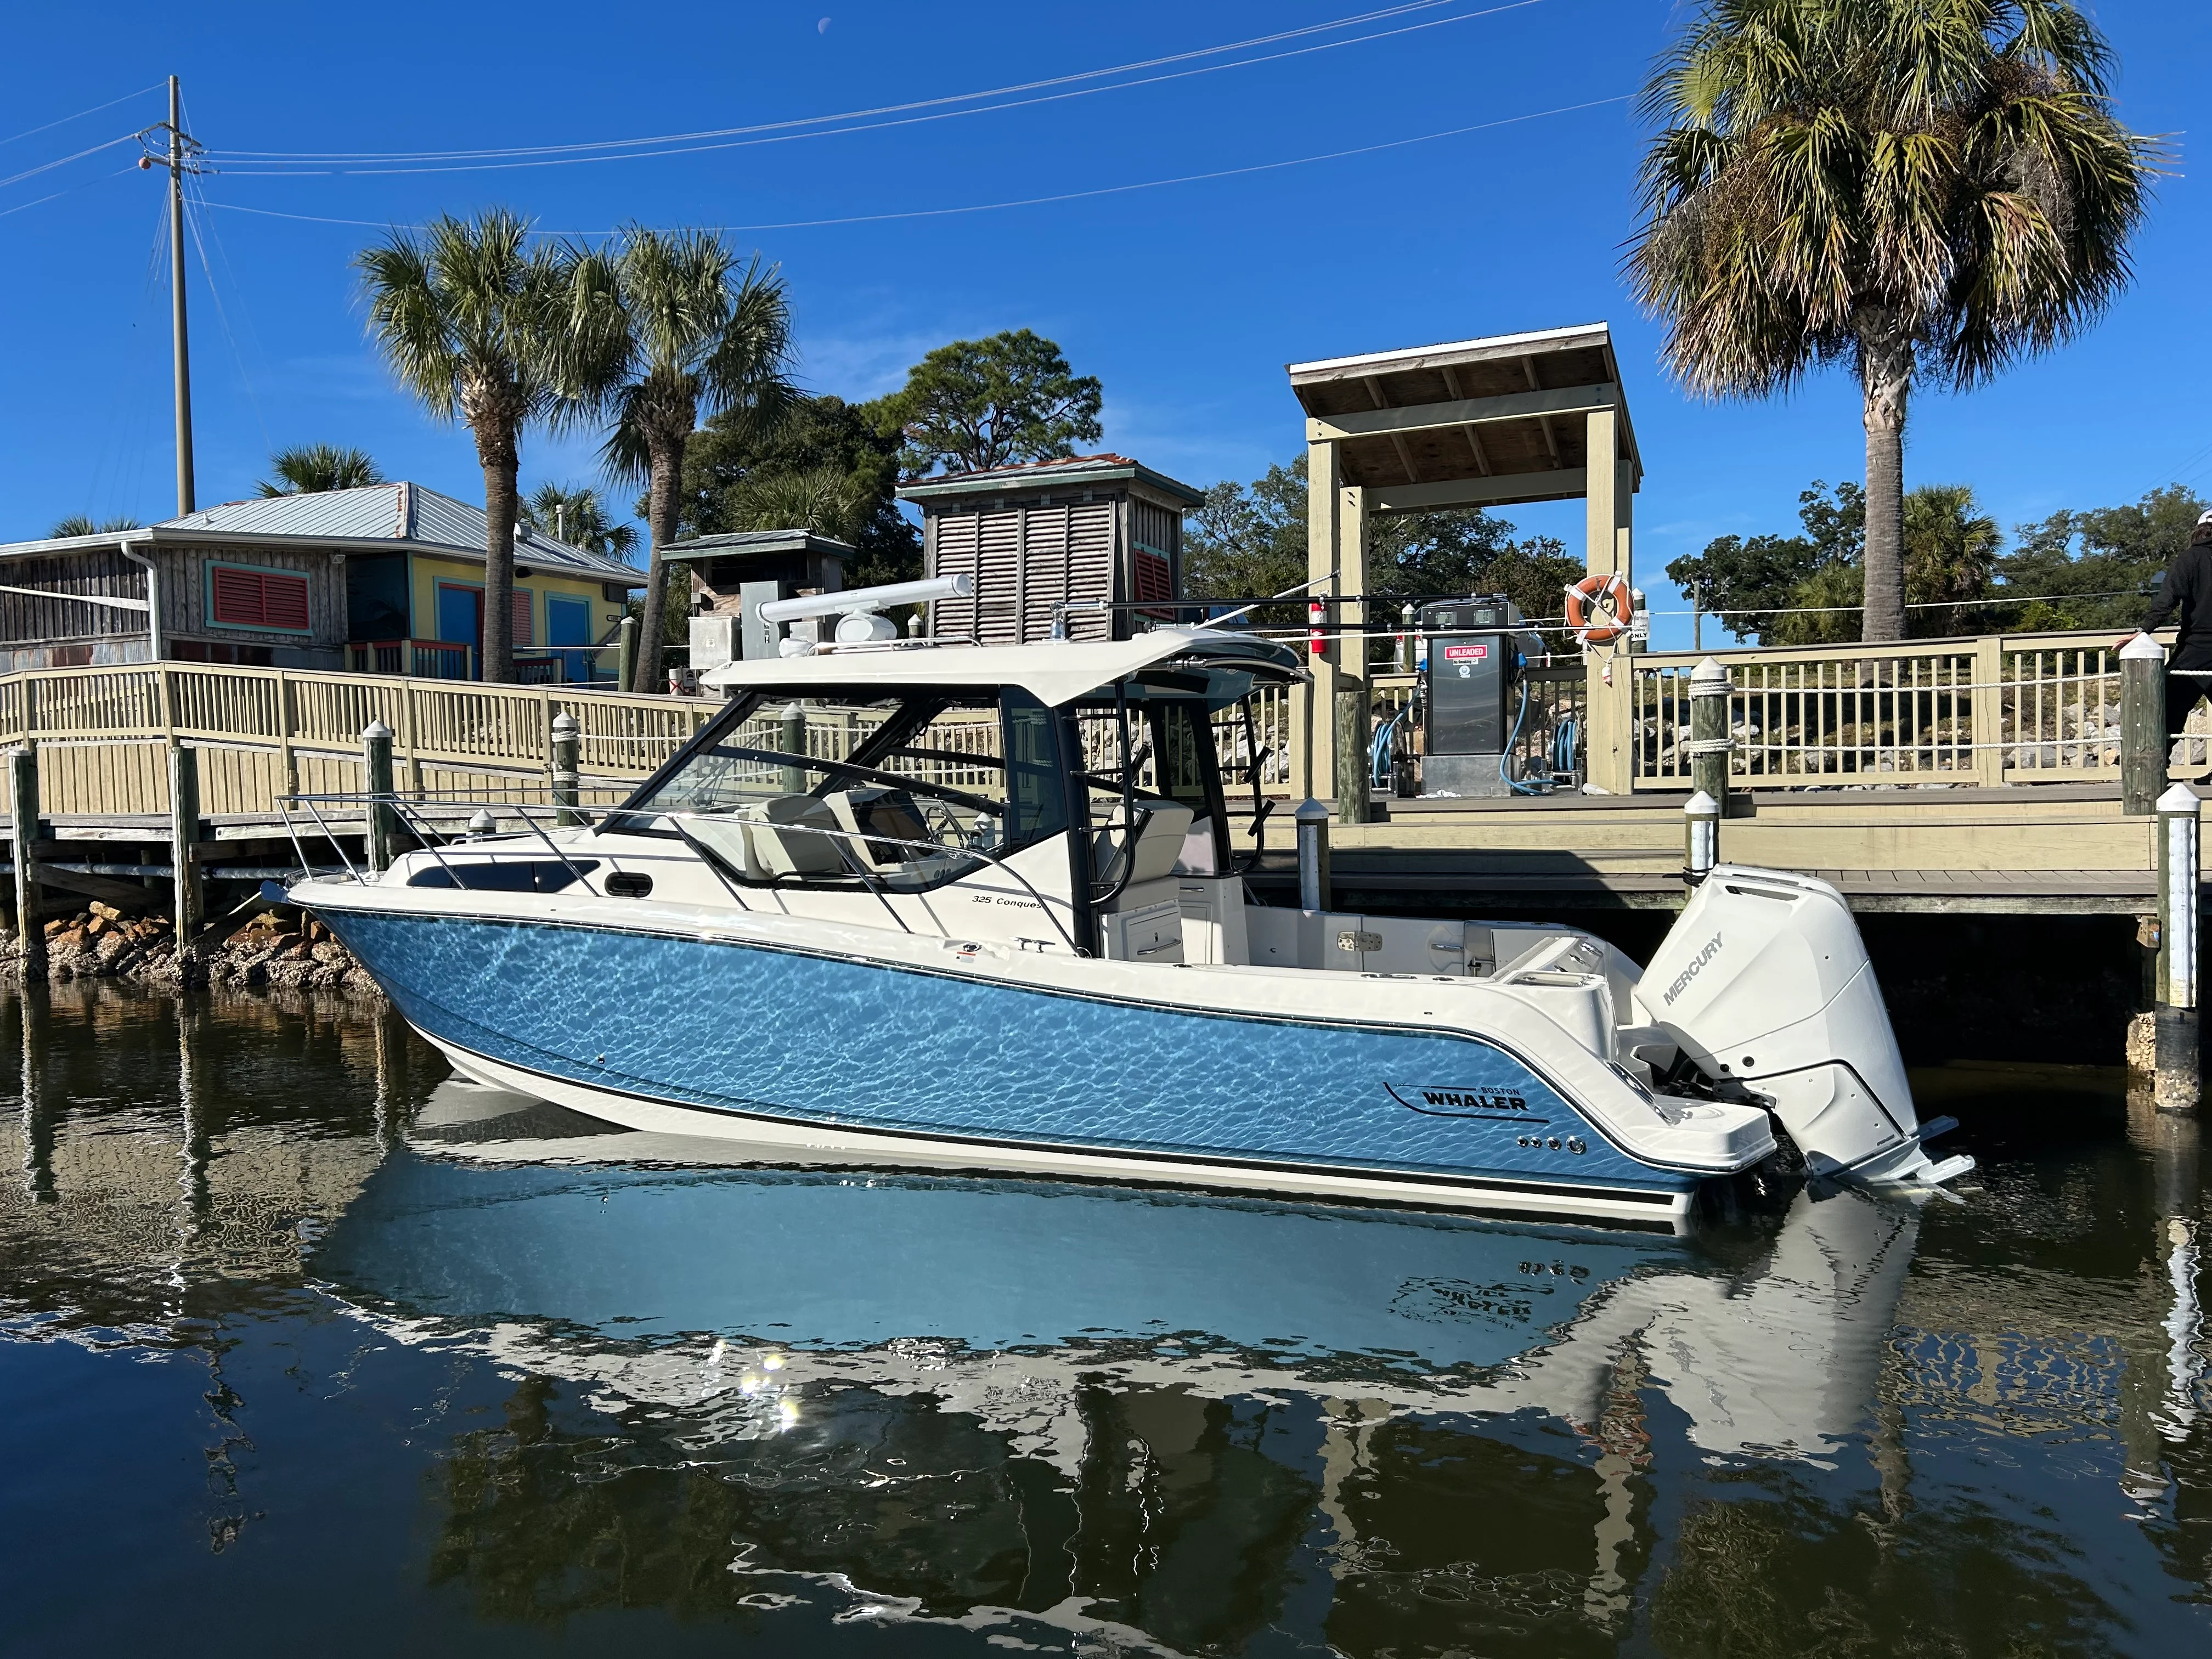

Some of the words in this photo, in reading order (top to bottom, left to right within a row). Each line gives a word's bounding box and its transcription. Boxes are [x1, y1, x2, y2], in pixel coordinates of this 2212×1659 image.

[1449, 648, 1483, 657] UNLEADED
[972, 895, 992, 904] 325
[996, 898, 1042, 909] Conques
[1663, 930, 1723, 1006] MERCURY
[1481, 1087, 1520, 1096] BOSTON
[1421, 1092, 1530, 1111] WHALER
